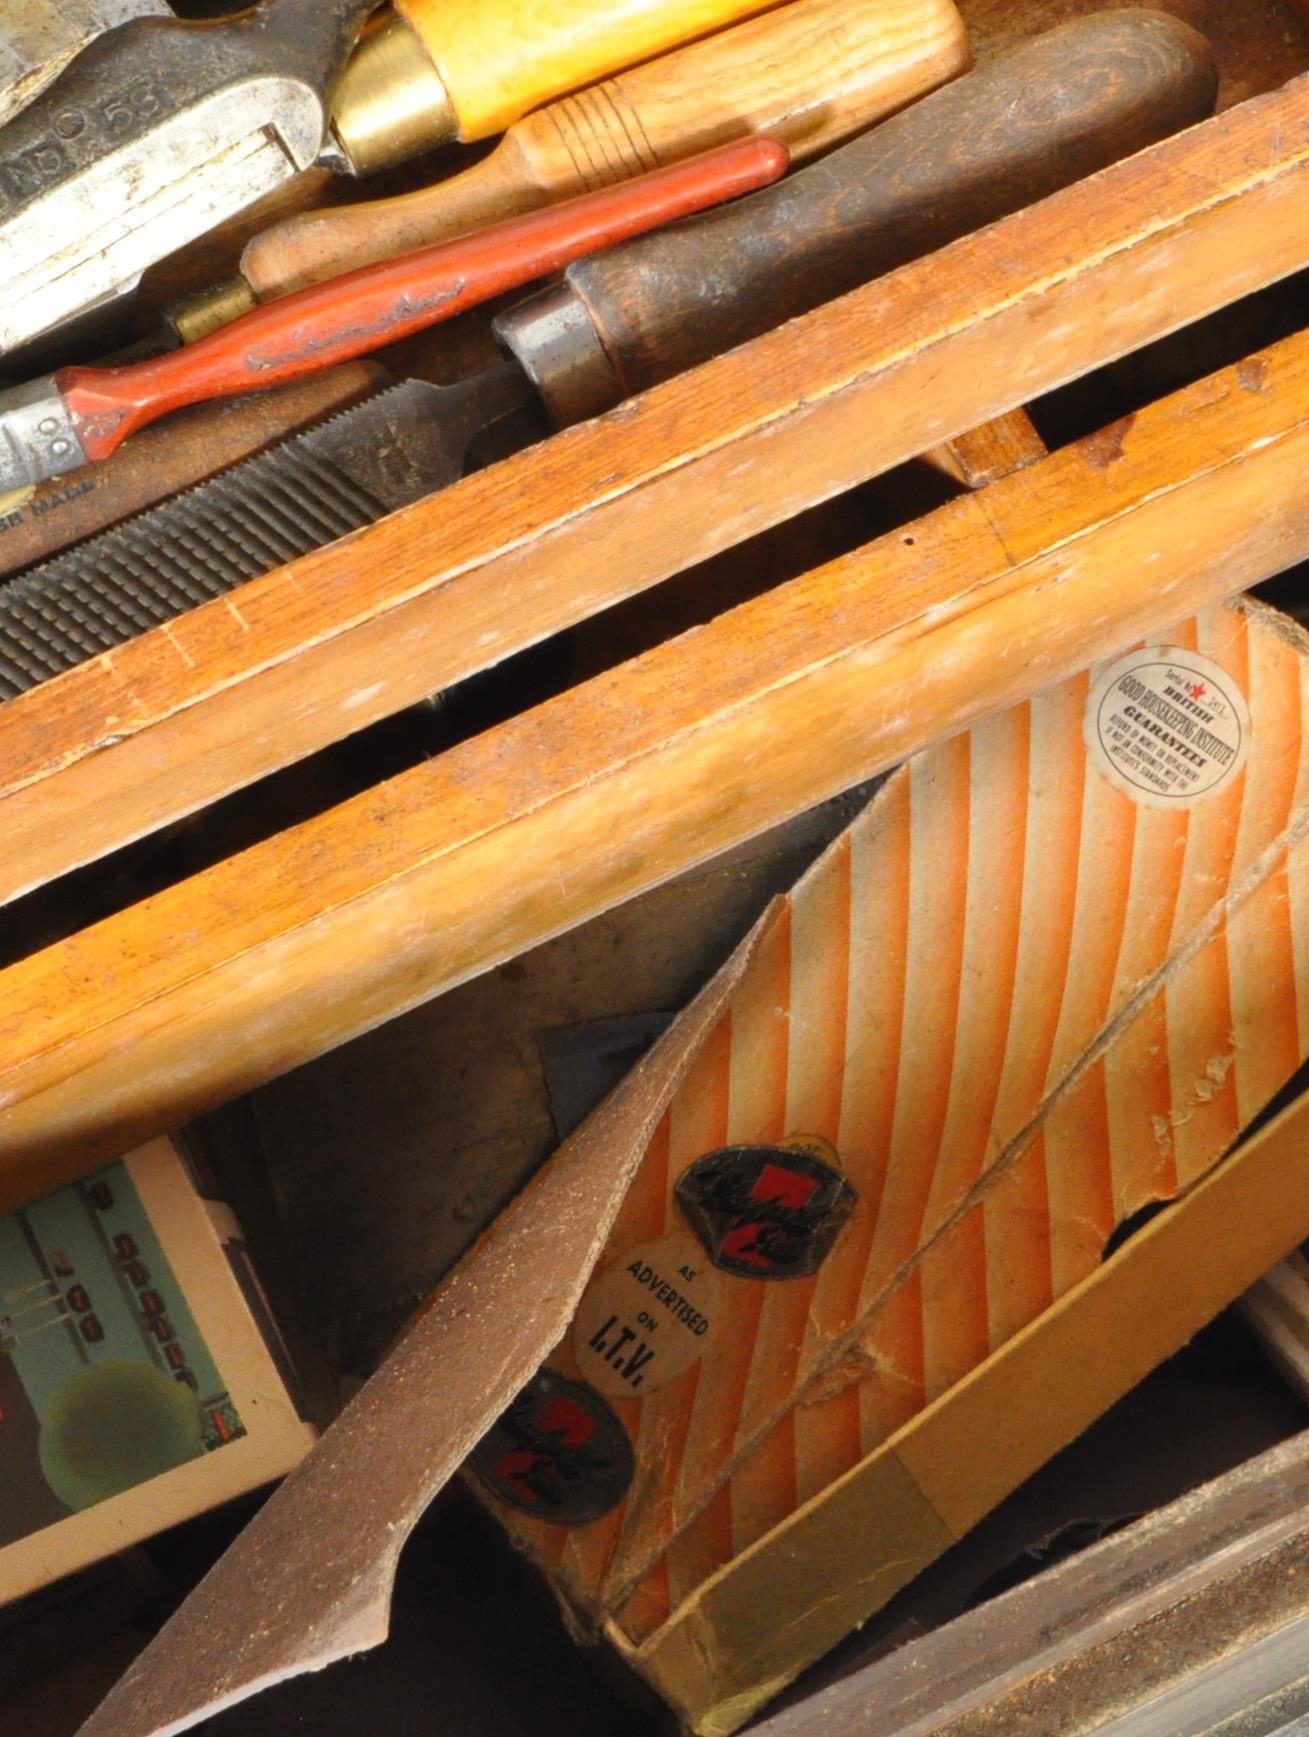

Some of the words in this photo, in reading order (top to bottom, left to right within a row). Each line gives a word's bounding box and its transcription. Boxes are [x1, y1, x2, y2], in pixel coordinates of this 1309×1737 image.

[1118, 675, 1146, 701] GOOD
[1138, 689, 1198, 740] HOUSEKEEPING
[1191, 727, 1235, 766] INSTITUTE
[1123, 705, 1208, 768] GUARANTEES
[1163, 685, 1214, 724] BRITISH
[1110, 713, 1132, 734] REFUND
[1165, 754, 1201, 782] REPLACEMENT
[626, 1259, 709, 1337] ADVERTISED
[678, 1264, 696, 1283] AS
[589, 1315, 655, 1388] I.T.V.
[636, 1312, 658, 1331] ON
